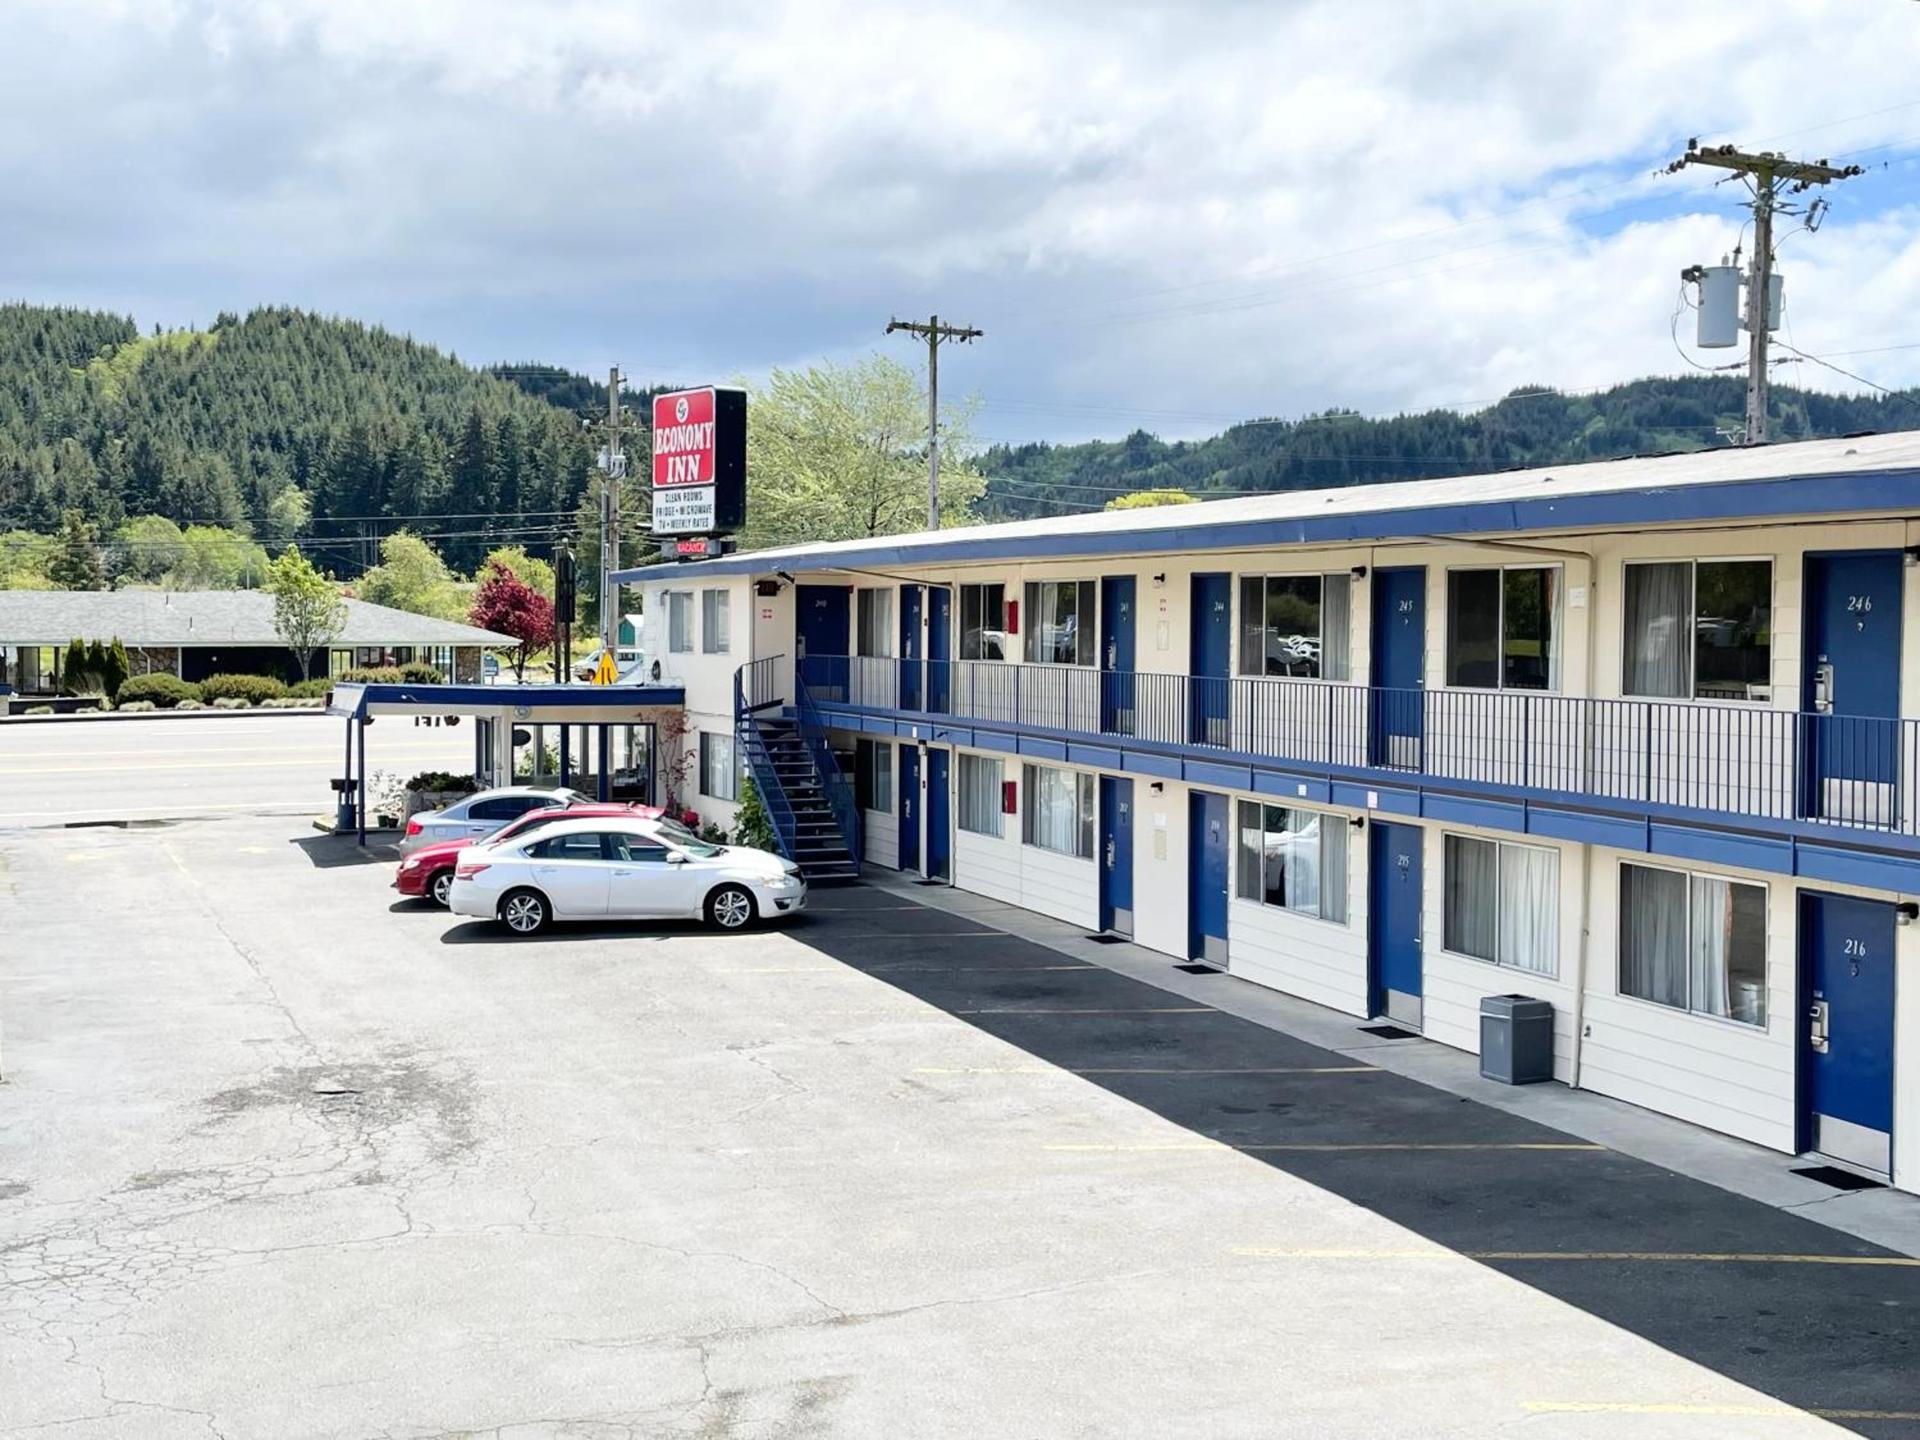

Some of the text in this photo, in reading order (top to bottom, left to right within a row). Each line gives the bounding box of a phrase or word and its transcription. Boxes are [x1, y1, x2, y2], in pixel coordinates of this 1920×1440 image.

[655, 422, 713, 454] ECONOMY
[666, 454, 701, 483] INN
[665, 491, 703, 503] CLEAN ROOMS
[1398, 600, 1413, 611] 245
[1847, 596, 1872, 611] 246
[1844, 938, 1866, 957] 216
